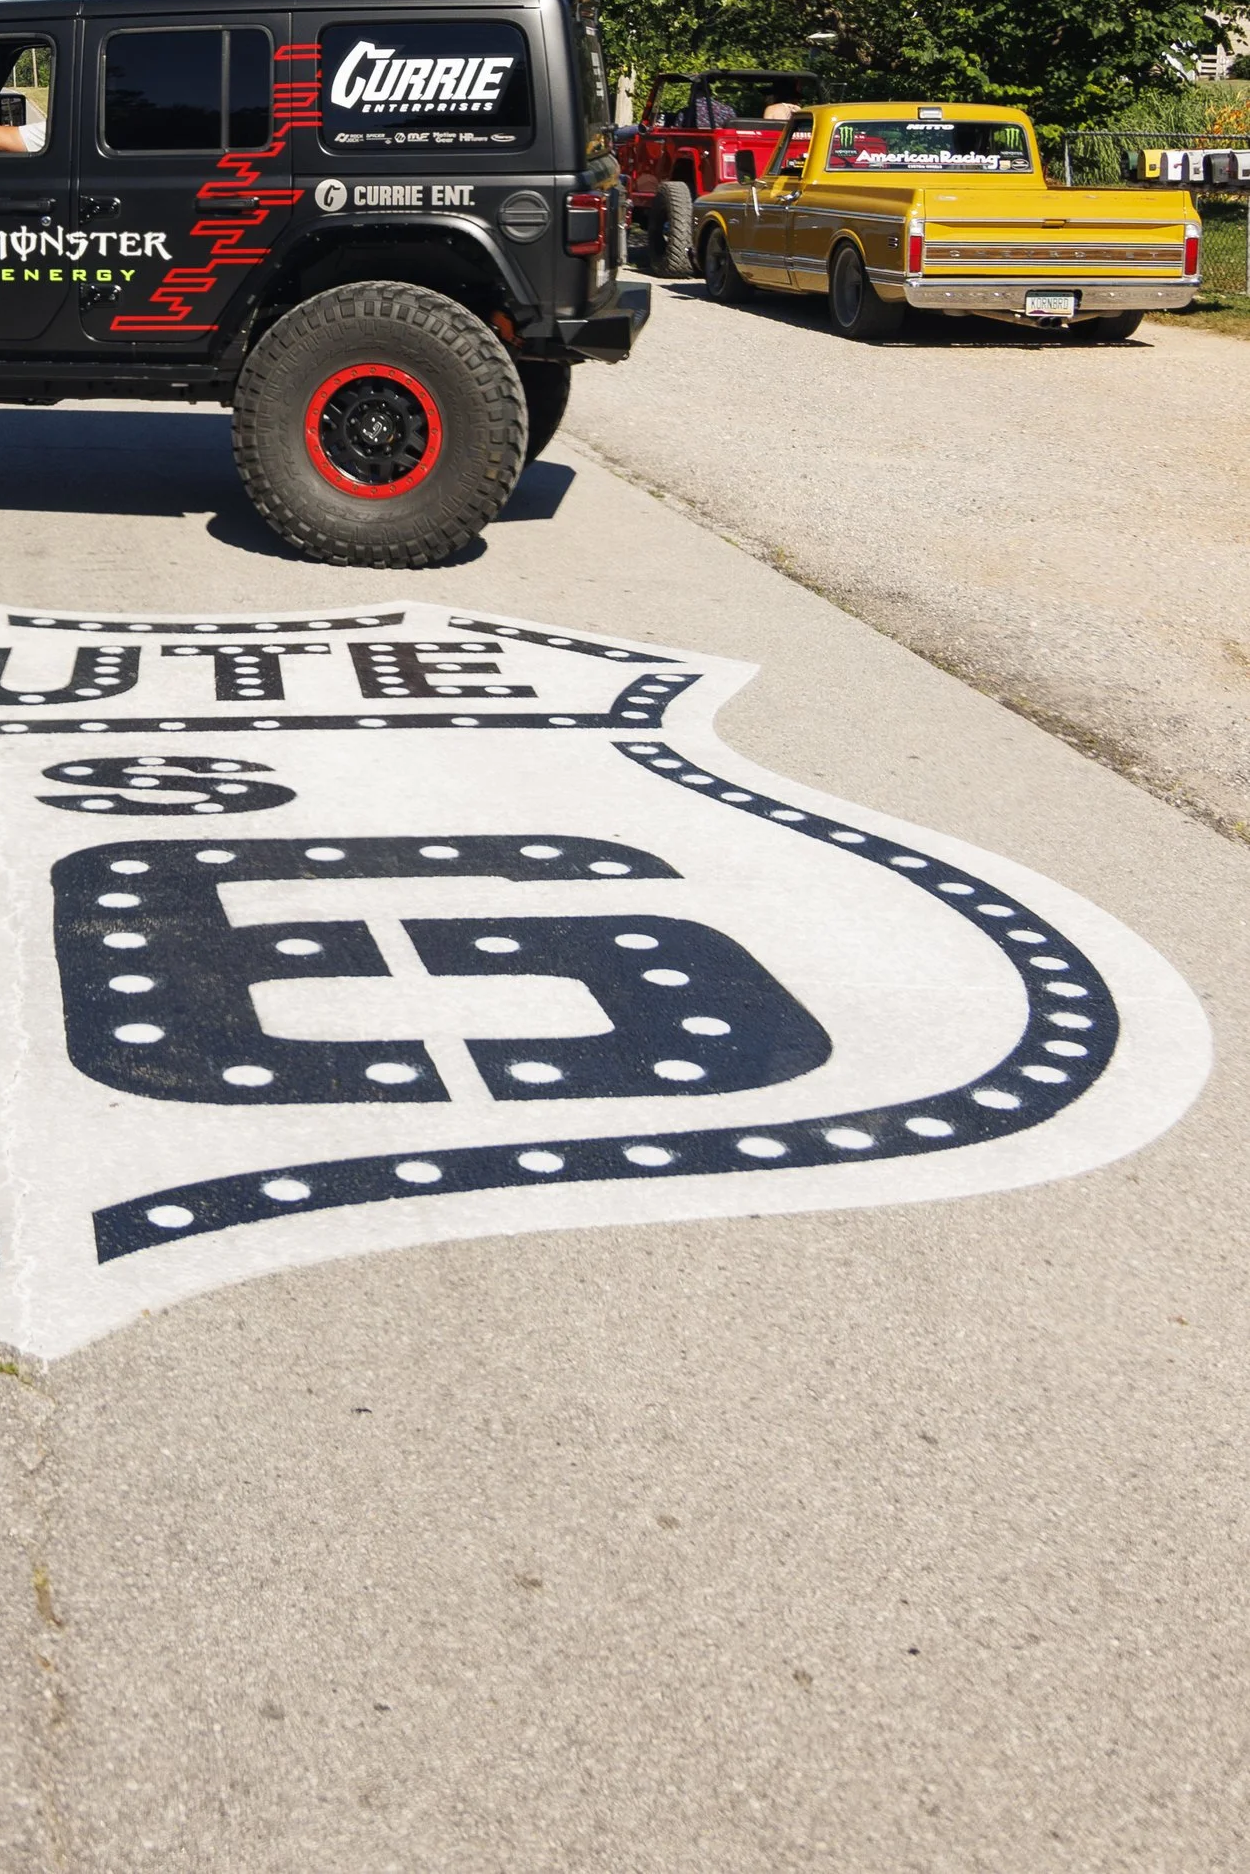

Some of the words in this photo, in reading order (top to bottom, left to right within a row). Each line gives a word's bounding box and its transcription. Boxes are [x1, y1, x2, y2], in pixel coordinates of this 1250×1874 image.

[330, 40, 515, 109] CURRIE
[361, 101, 494, 114] ENTERPRISES
[906, 123, 955, 131] NITTO
[353, 185, 424, 207] CURRIE
[431, 185, 476, 207] ENT.
[948, 248, 1160, 259] CHEVROLET
[0, 268, 136, 282] ENERGY
